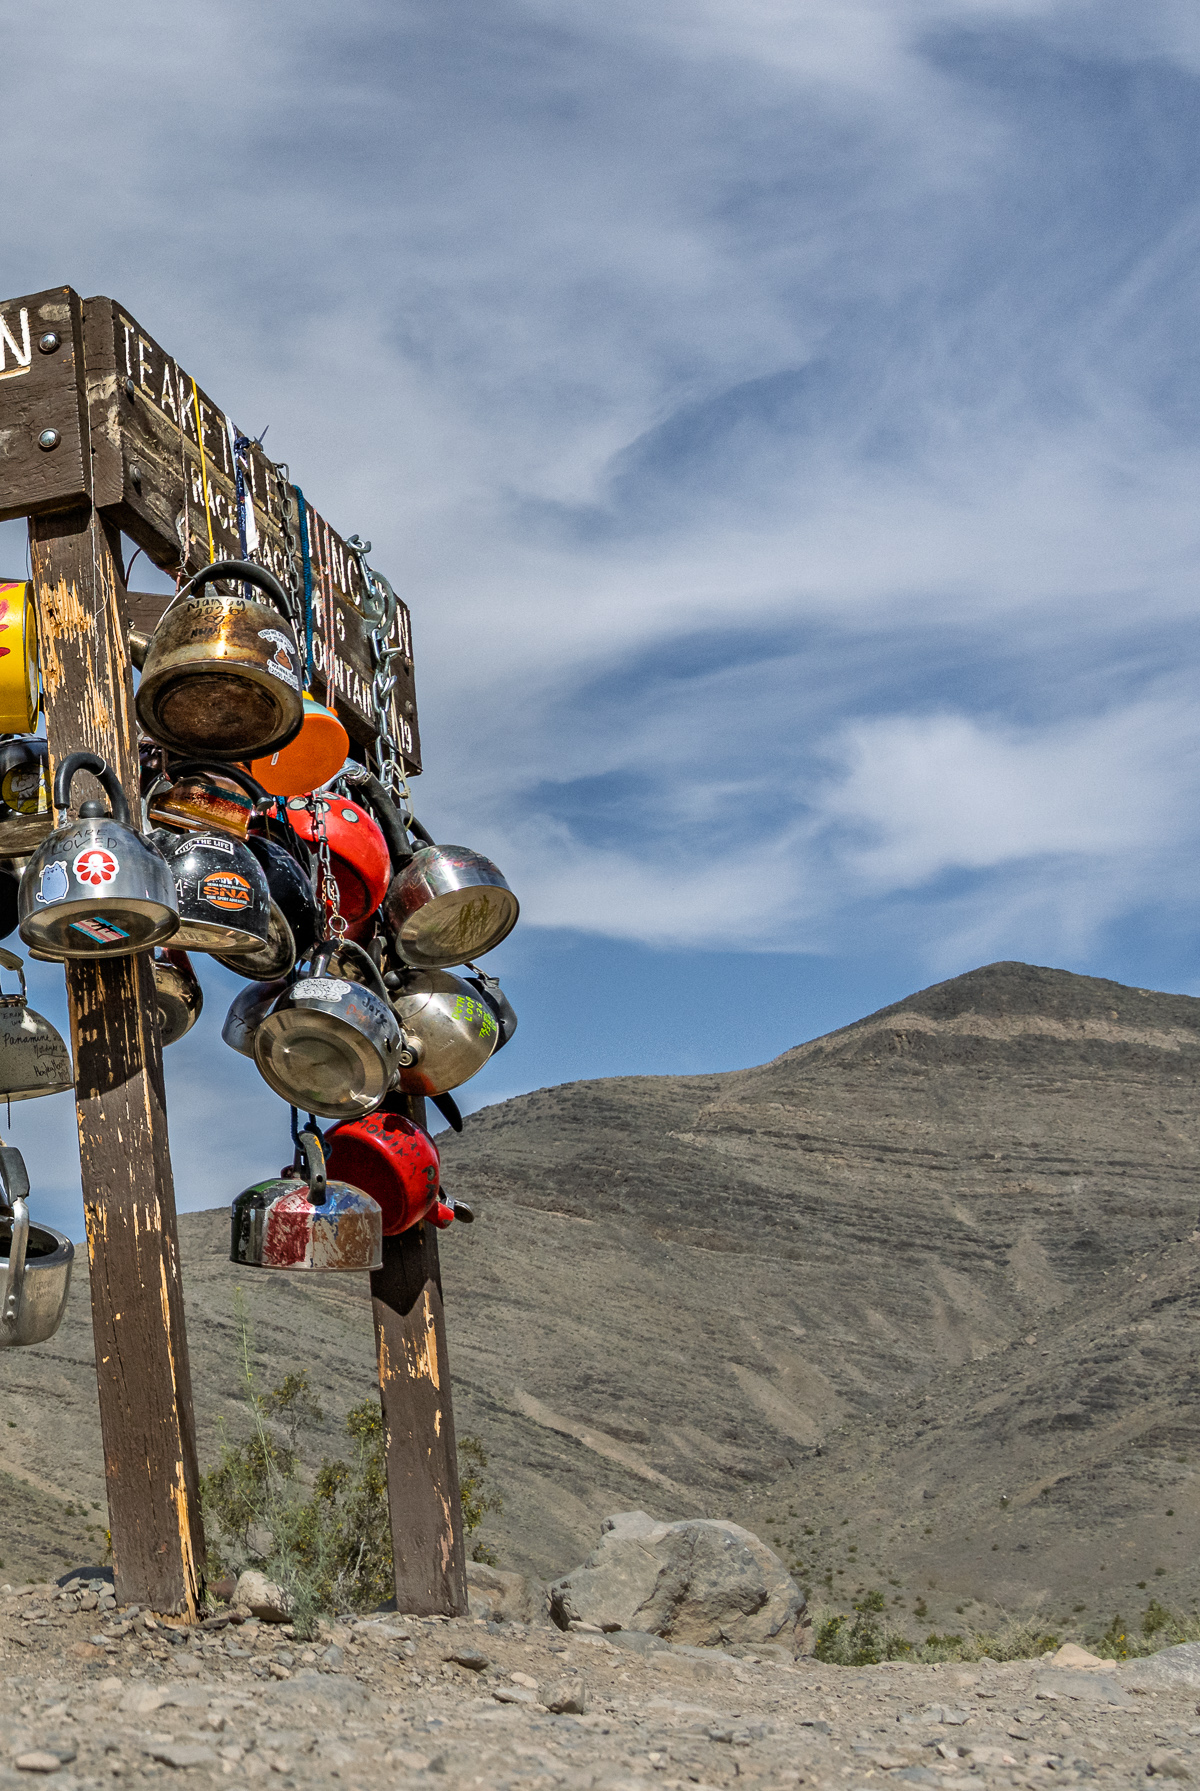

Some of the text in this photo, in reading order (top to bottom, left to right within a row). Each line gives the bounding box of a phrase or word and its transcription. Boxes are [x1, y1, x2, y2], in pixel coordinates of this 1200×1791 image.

[119, 313, 284, 529] TEAKETLE
[399, 714, 413, 754] 19
[180, 841, 193, 853] LIVE
[214, 841, 230, 850] LIFE
[203, 886, 251, 902] SNA
